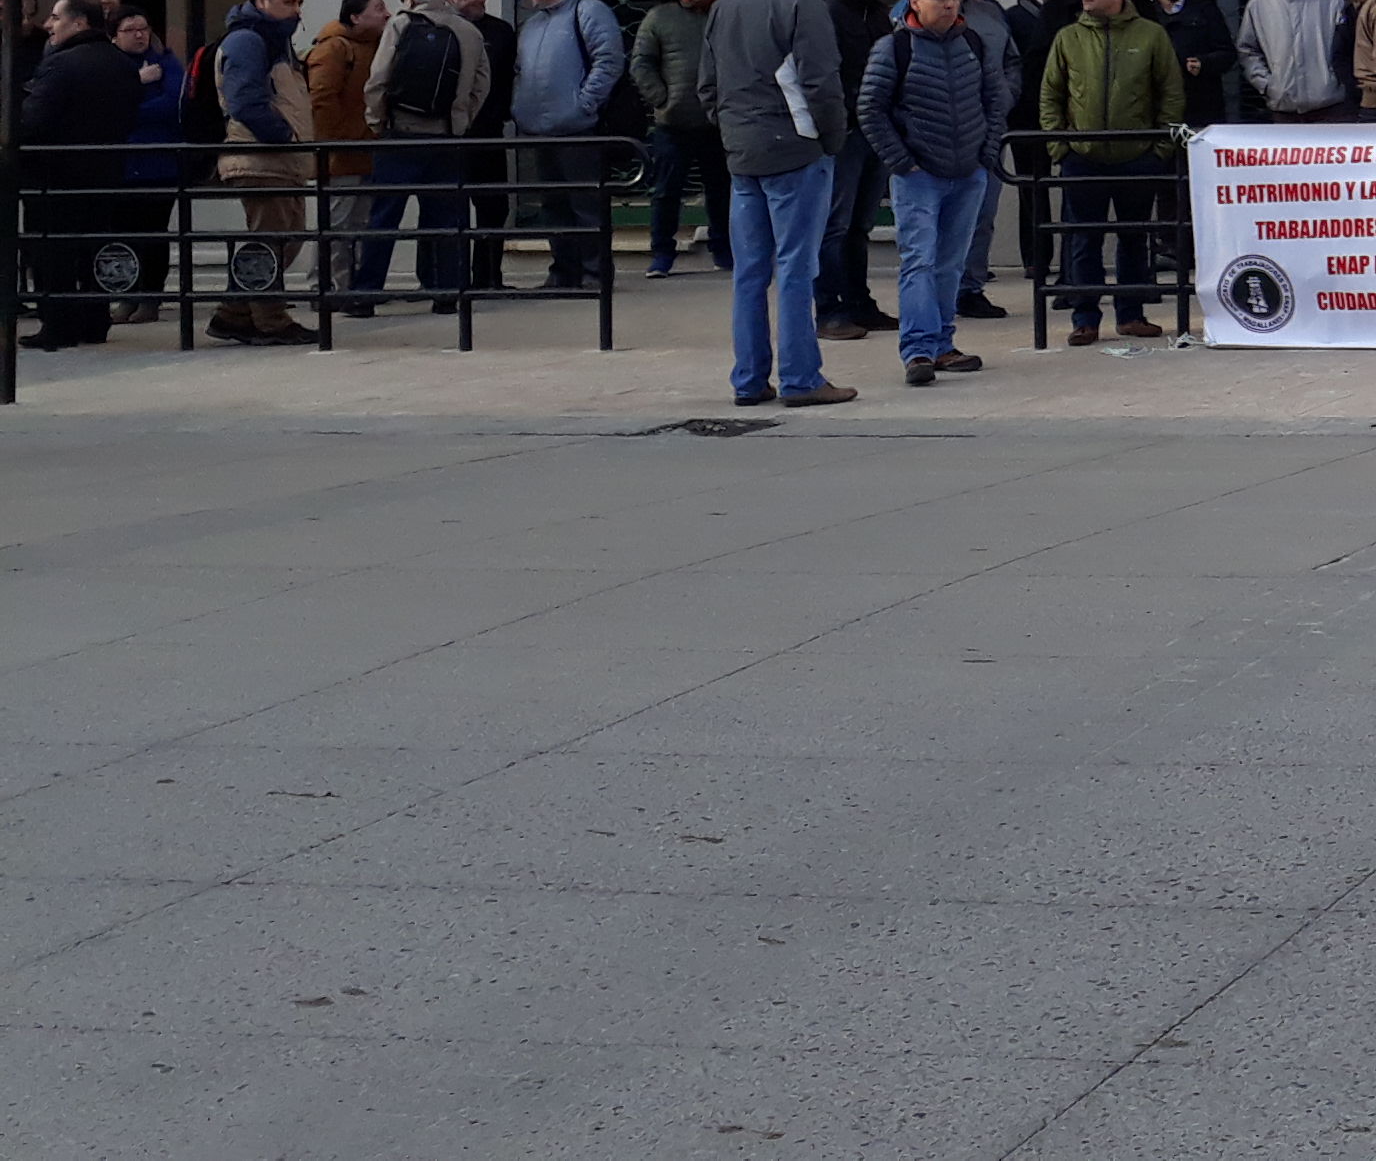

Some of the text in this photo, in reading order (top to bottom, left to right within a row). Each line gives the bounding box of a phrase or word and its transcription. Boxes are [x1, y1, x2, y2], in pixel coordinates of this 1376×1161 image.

[1214, 145, 1347, 167] TRABAJADORES
[1351, 145, 1372, 164] DE
[1216, 185, 1233, 205] EL
[1236, 181, 1341, 203] PATRIMONIO
[1345, 181, 1357, 200] Y
[1326, 254, 1370, 276] ENAP
